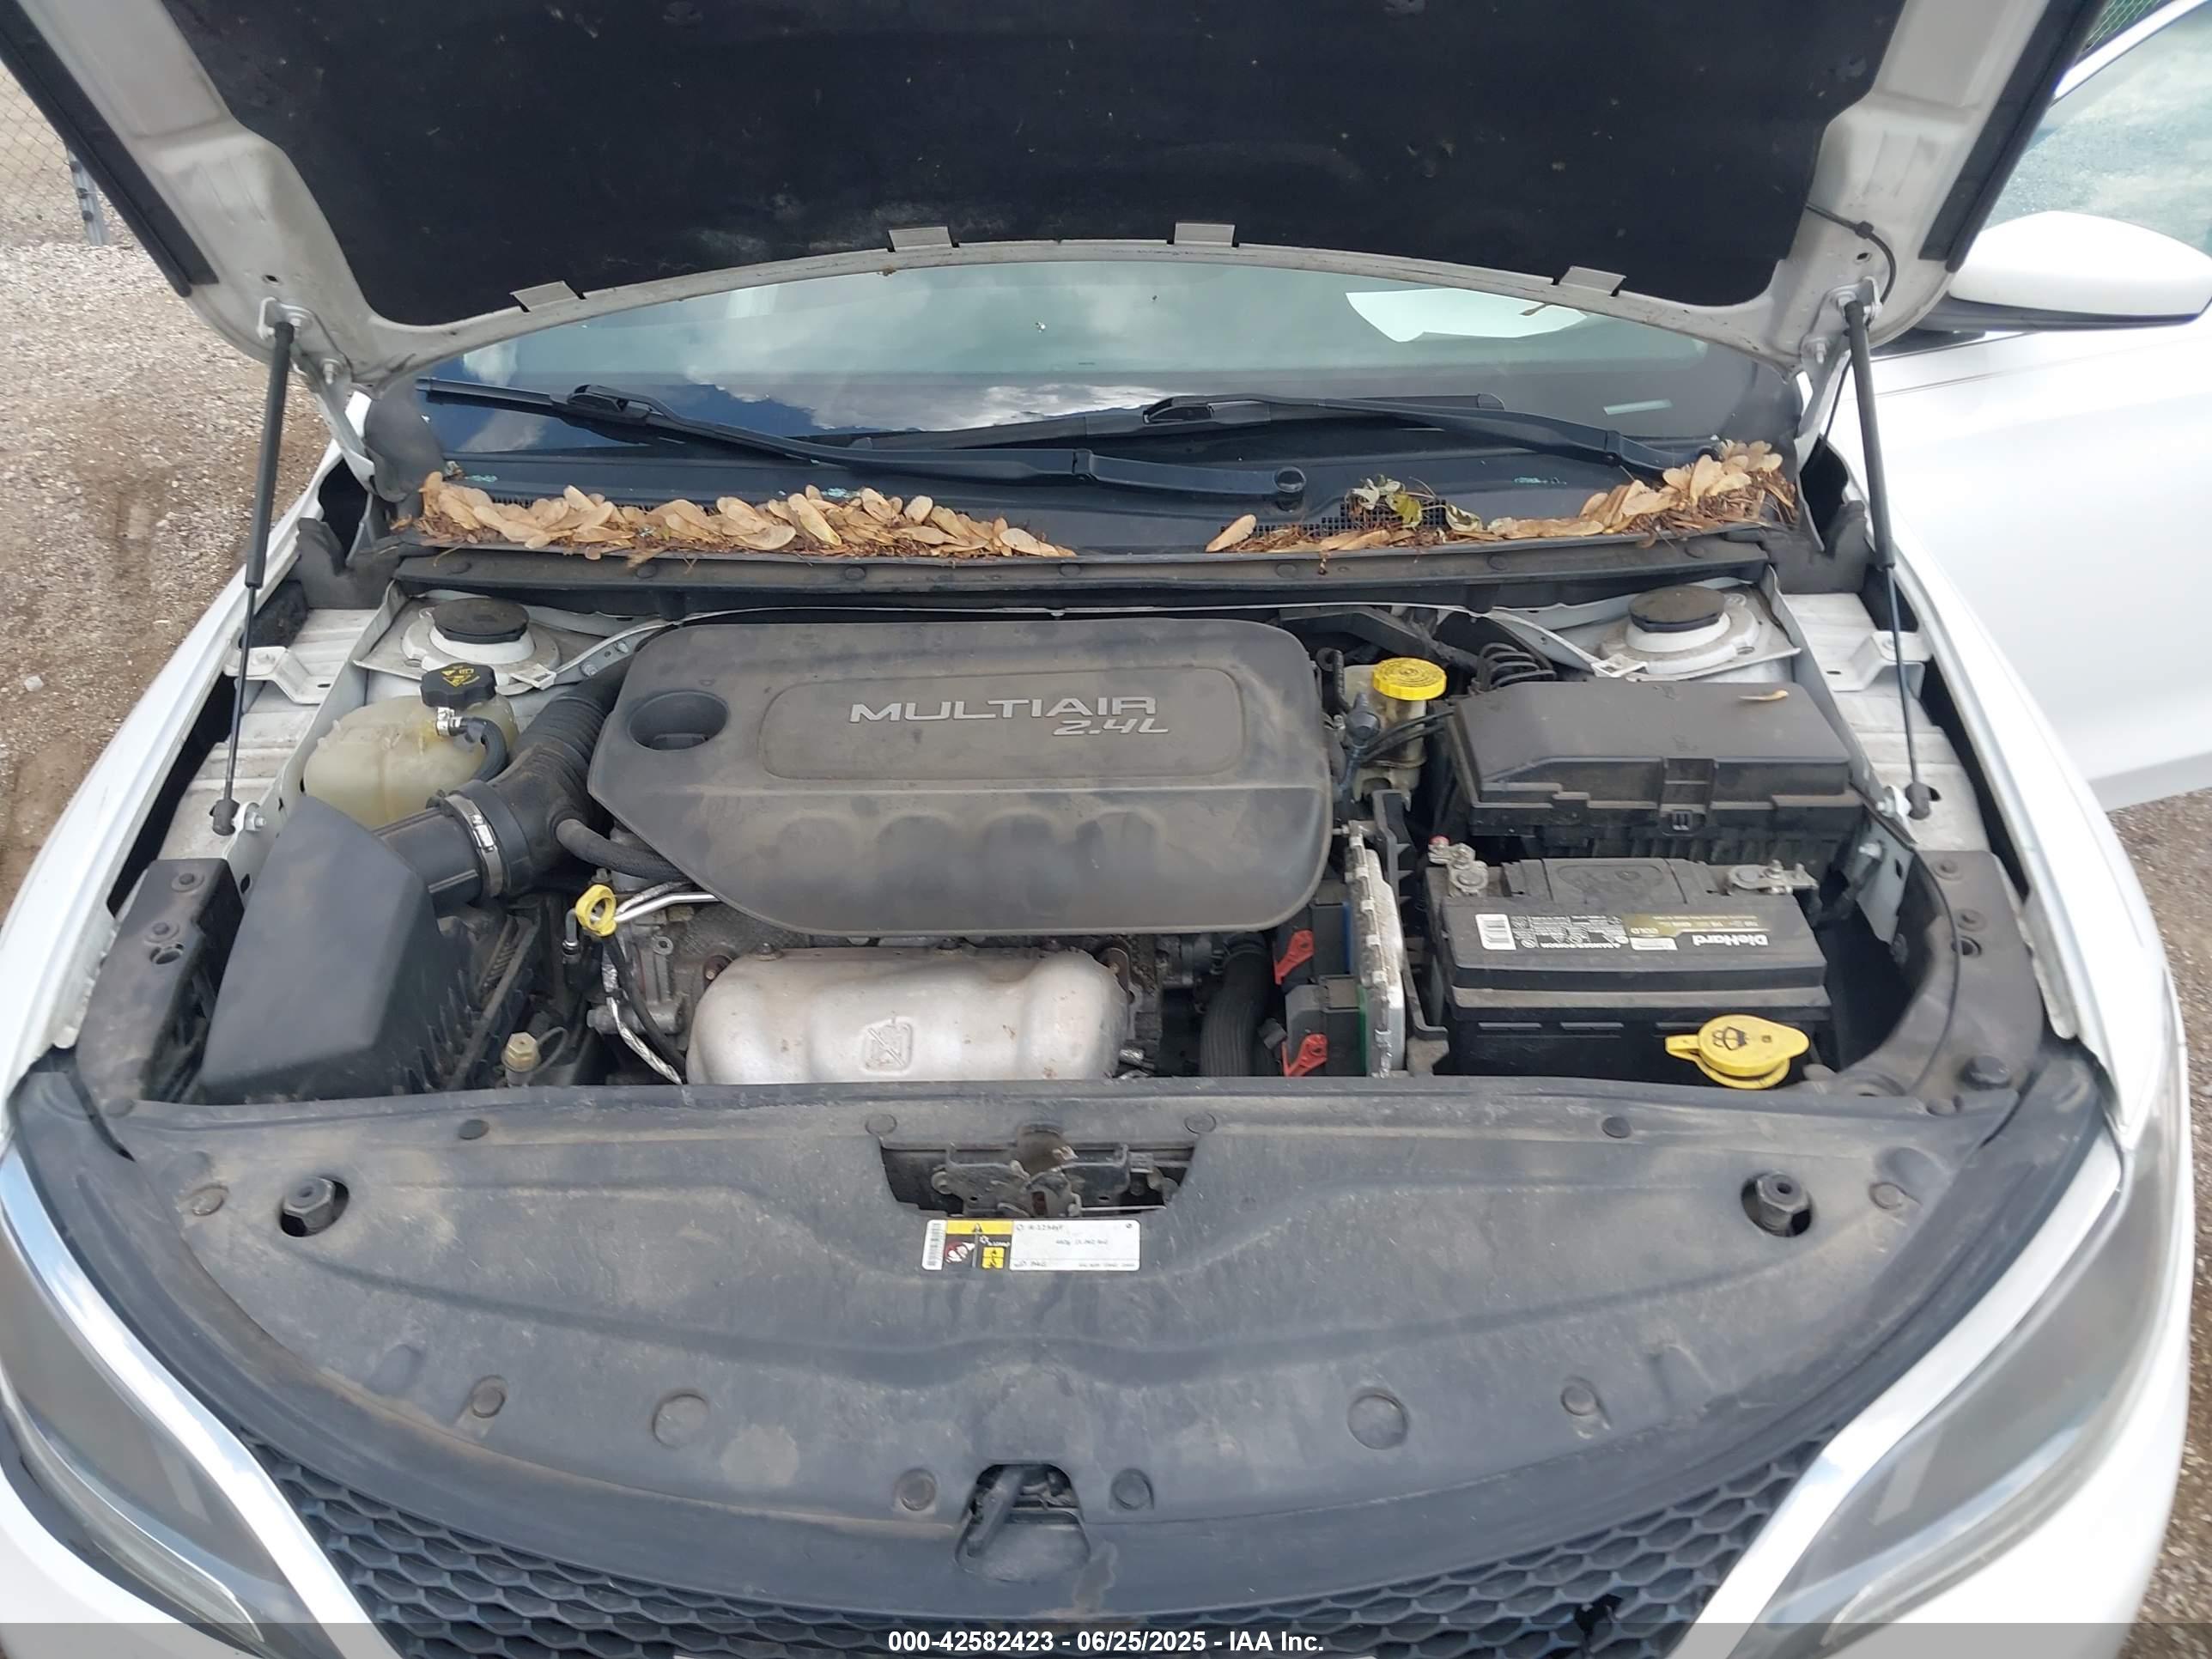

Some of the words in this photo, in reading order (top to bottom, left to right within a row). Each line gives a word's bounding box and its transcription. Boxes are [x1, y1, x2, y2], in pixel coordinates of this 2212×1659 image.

[849, 696, 1158, 723] MULTIAIR
[1052, 718, 1170, 736] 2.4L
[1692, 933, 1769, 946] DieHard
